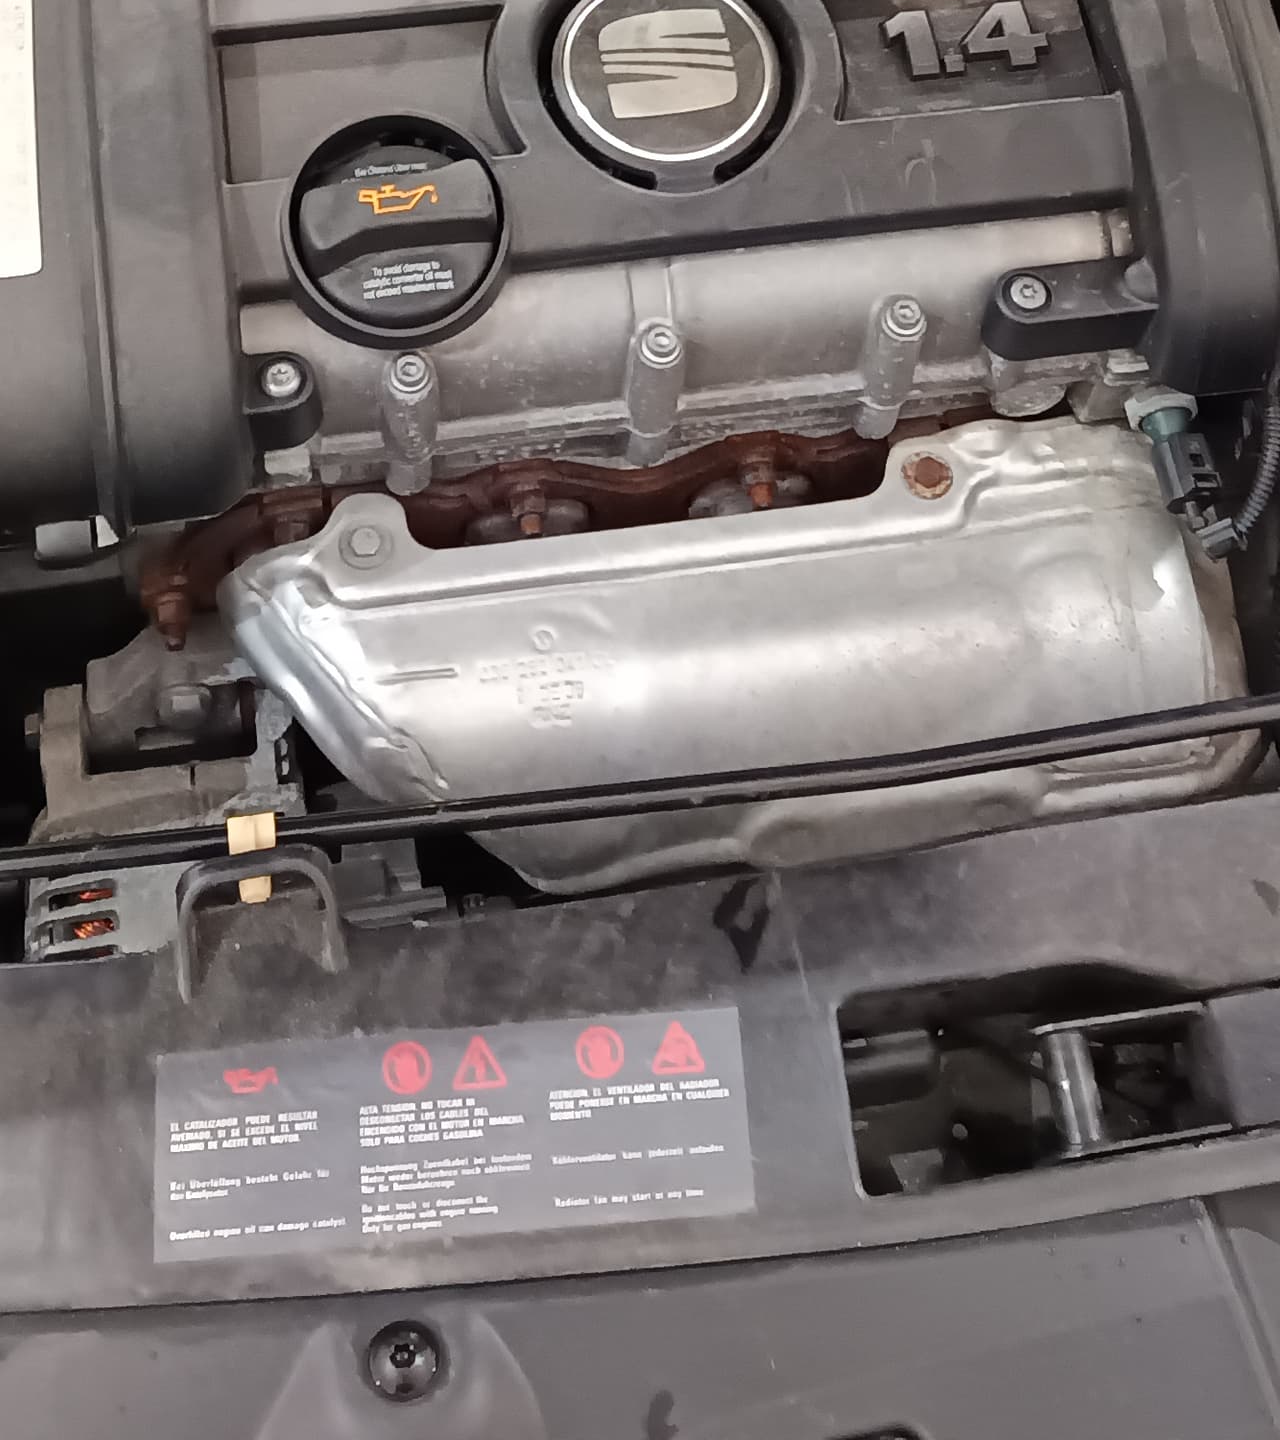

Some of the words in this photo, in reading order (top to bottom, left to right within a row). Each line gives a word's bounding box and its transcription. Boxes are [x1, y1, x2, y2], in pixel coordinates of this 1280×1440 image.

[880, 0, 1049, 79] 1.4
[371, 267, 382, 277] To
[383, 264, 402, 276] avoid
[403, 262, 431, 273] damage
[431, 261, 440, 269] to
[363, 277, 391, 289] catalytic
[392, 273, 424, 284] converter
[424, 271, 434, 280] oil
[434, 269, 452, 279] must
[363, 290, 375, 299] not
[376, 286, 401, 298] exceed
[402, 283, 435, 293] maximum
[436, 280, 454, 290] mark
[607, 1083, 655, 1095] VENTILADOR
[660, 1082, 674, 1091] DEL
[679, 1079, 719, 1089] RADIADOR
[359, 1105, 378, 1115] ALTA
[437, 1099, 463, 1108] TOCAR
[549, 1100, 574, 1110] PUEDE
[579, 1097, 614, 1108] PONERSE
[633, 1093, 668, 1104] MARCHA
[686, 1088, 730, 1100] CUALQUIER
[170, 1122, 179, 1132] EL
[184, 1117, 238, 1131] CATALIZADOR
[245, 1114, 270, 1125] PUEDE
[278, 1111, 318, 1122] RESULTAR
[421, 1111, 436, 1121] LOS
[439, 1109, 469, 1119] CABLES
[550, 1109, 592, 1120] MOMENTO
[245, 1125, 275, 1136] EXCEDE
[294, 1121, 318, 1131] NIVEL
[359, 1125, 405, 1136] ENCENDIDO
[408, 1123, 426, 1132] CON
[428, 1122, 438, 1131] EL
[441, 1119, 470, 1130] MOTOR
[473, 1118, 484, 1127] EN
[488, 1114, 525, 1126] MARCHA
[207, 1140, 218, 1150] DE
[222, 1138, 248, 1148] ACEITE
[252, 1136, 267, 1146] DEL
[360, 1137, 381, 1147] SOLO
[384, 1135, 405, 1145] PARA
[408, 1132, 439, 1143] COCHES
[443, 1129, 484, 1140] GASOLINA
[594, 1195, 608, 1204] fan
[611, 1195, 628, 1204] may
[632, 1193, 651, 1202] start
